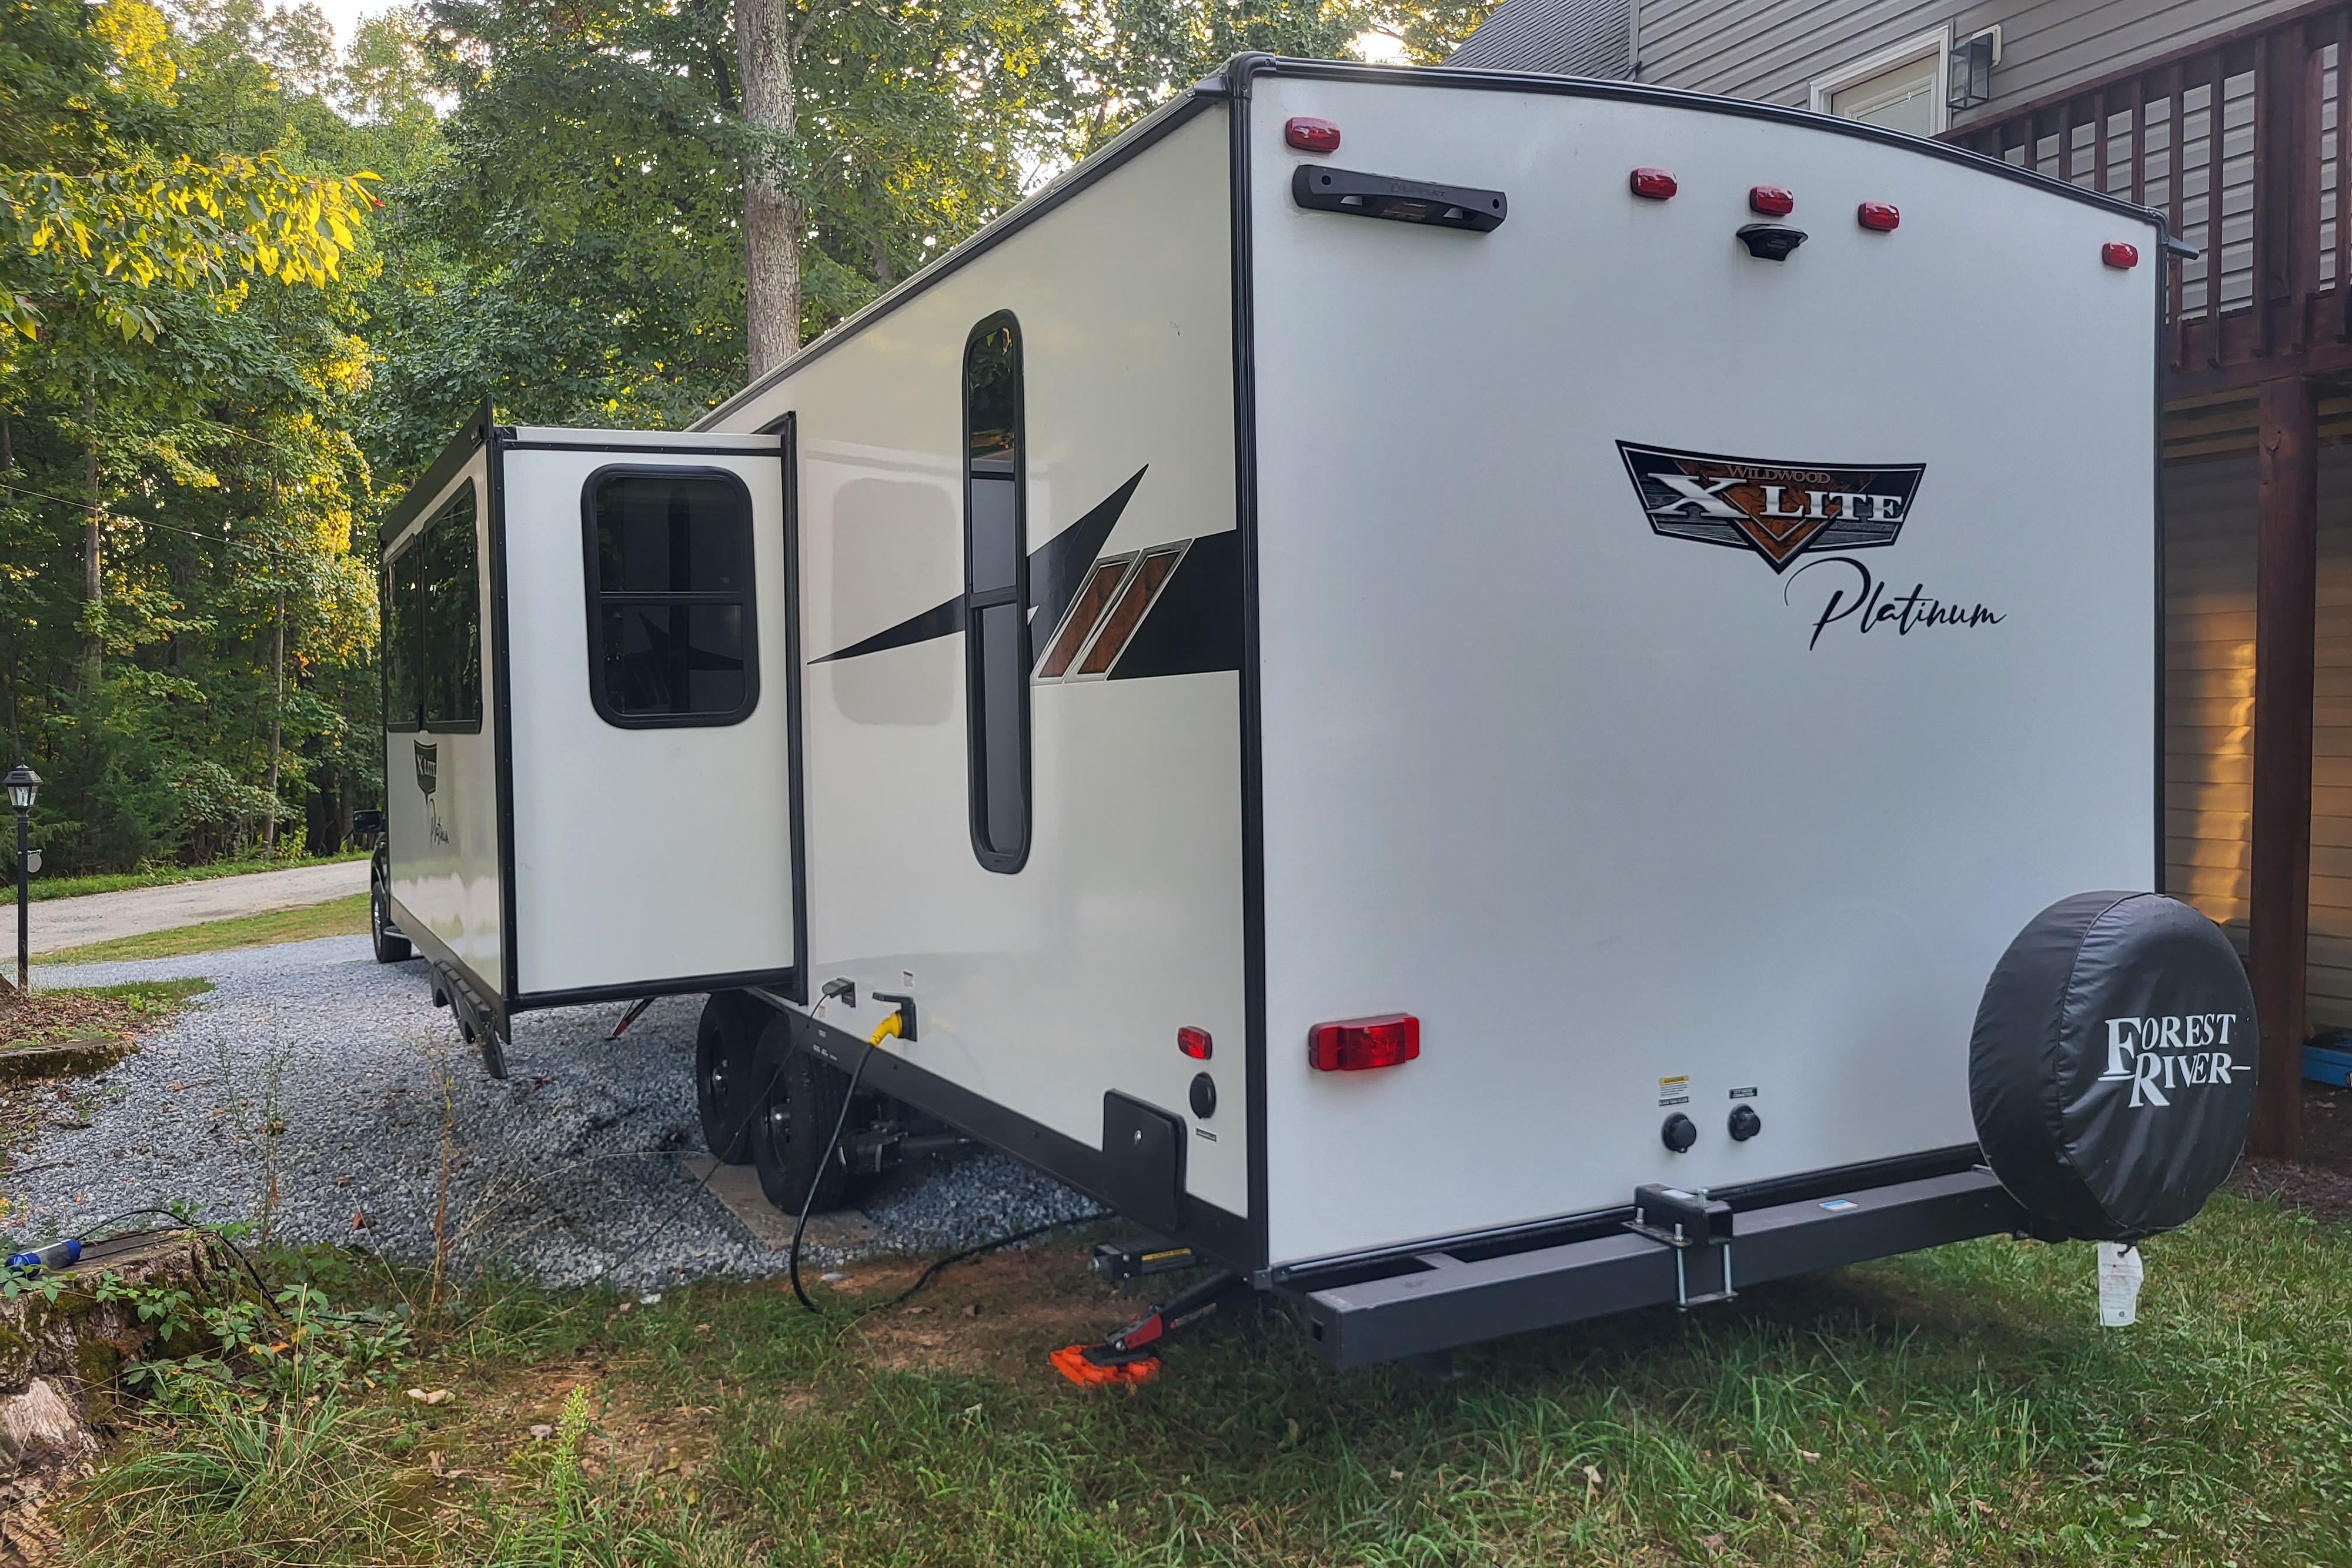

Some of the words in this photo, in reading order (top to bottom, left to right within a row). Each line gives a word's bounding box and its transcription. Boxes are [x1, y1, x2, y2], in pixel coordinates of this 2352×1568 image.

[1726, 464, 1830, 484] WILDWOOD
[1784, 556, 2007, 651] Platinum
[2103, 1013, 2236, 1075] FOREST
[2128, 1052, 2232, 1108] RIVER
